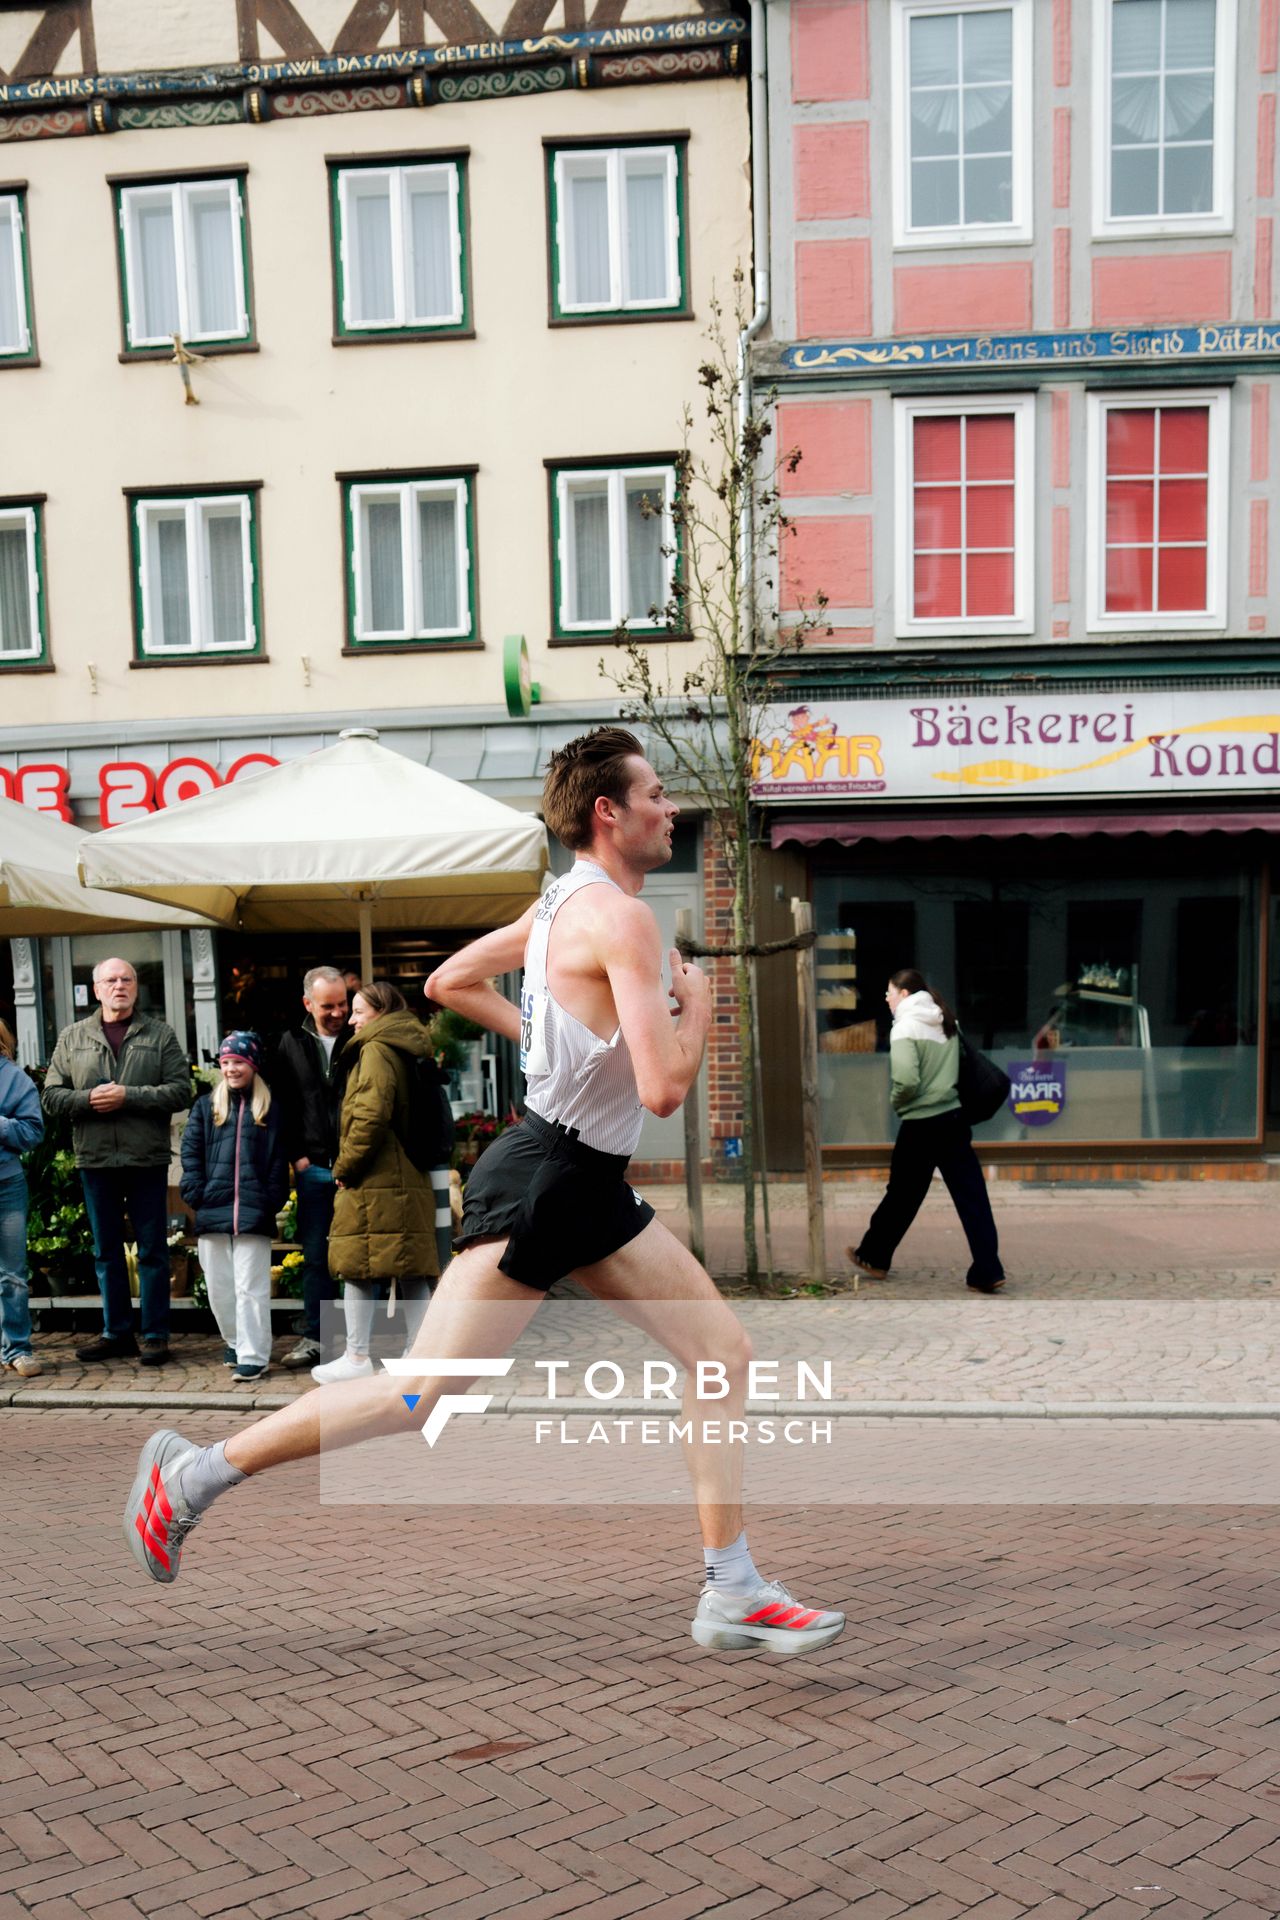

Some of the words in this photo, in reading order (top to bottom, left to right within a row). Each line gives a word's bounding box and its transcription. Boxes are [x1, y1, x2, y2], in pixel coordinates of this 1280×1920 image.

[600, 26, 654, 46] ANNO
[666, 20, 706, 40] 1648
[909, 703, 1135, 747] Bäckerei
[751, 735, 884, 782] NARR
[1148, 732, 1280, 777] Kond
[1011, 1082, 1062, 1100] NARR
